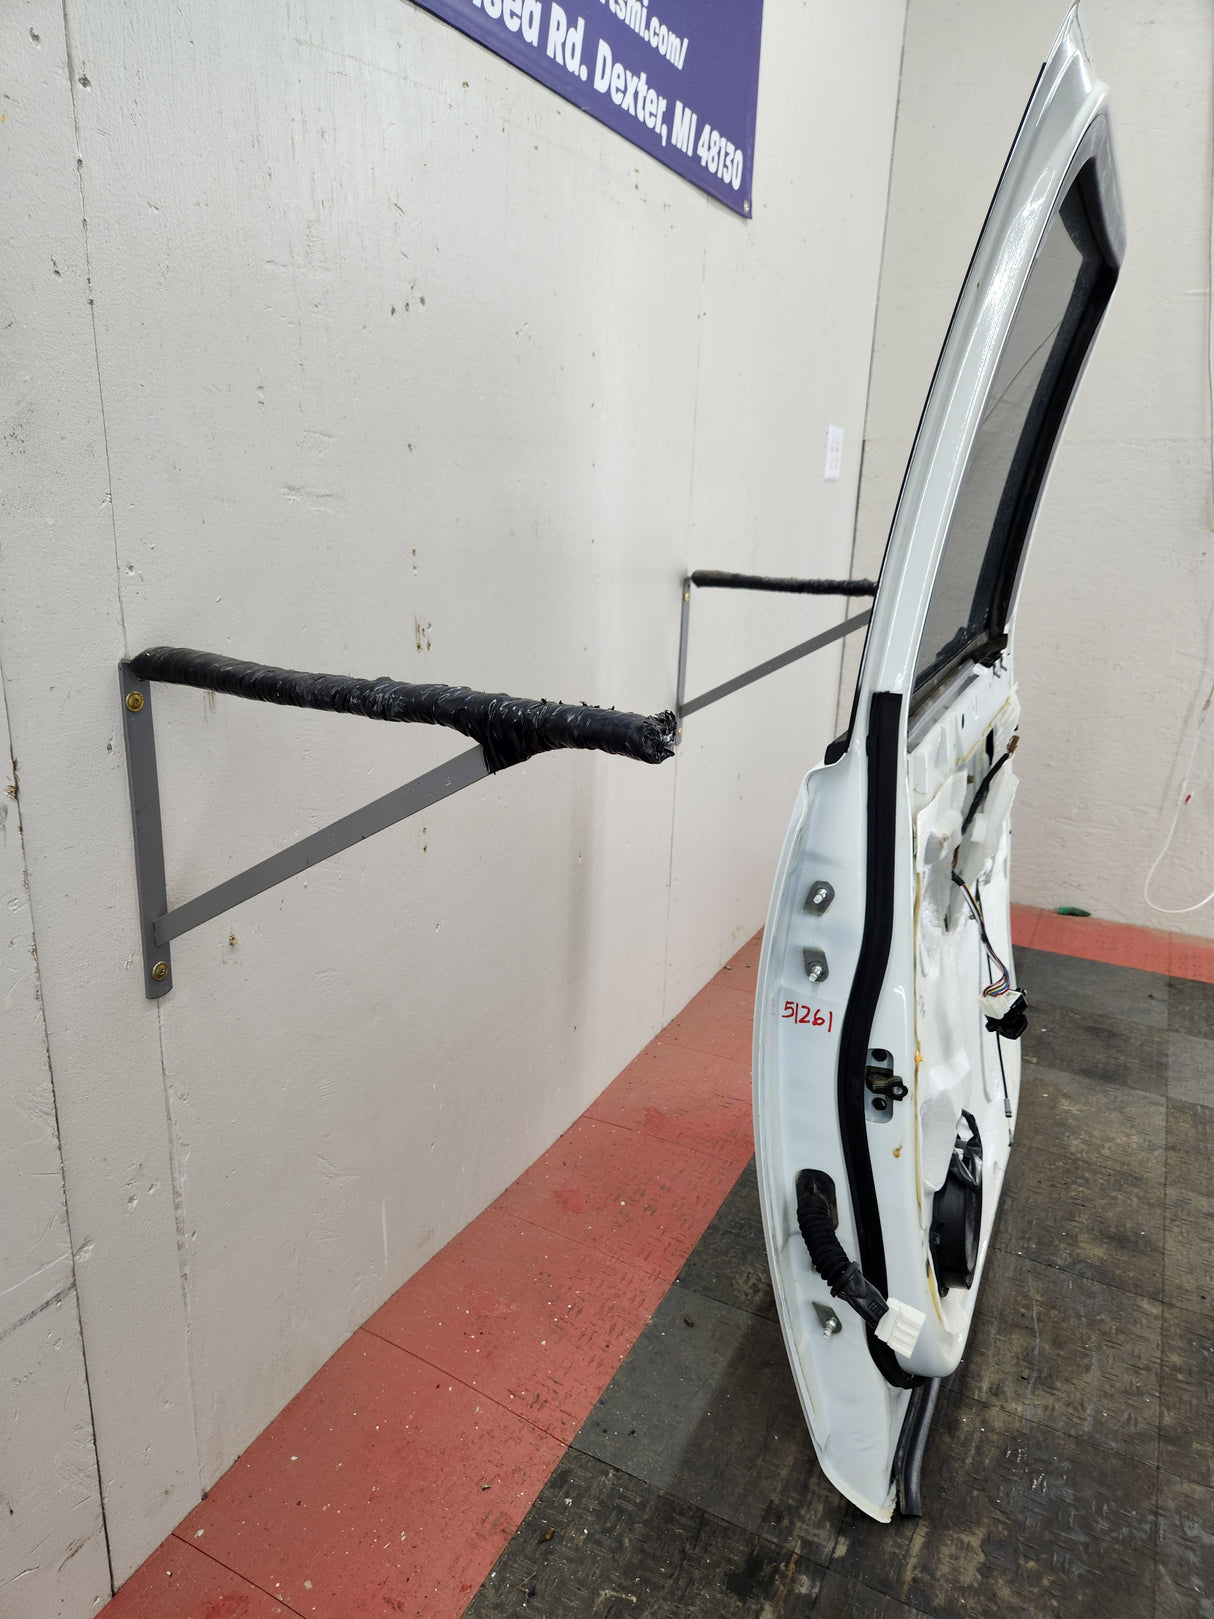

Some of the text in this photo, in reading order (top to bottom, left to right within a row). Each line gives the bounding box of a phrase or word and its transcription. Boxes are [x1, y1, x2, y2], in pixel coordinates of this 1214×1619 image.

[599, 0, 689, 71] smi.com/
[546, 1, 588, 82] Rd.
[593, 38, 668, 147] Dexter,
[671, 100, 697, 157] MI
[697, 124, 744, 191] 48130
[781, 1000, 833, 1033] 51261
